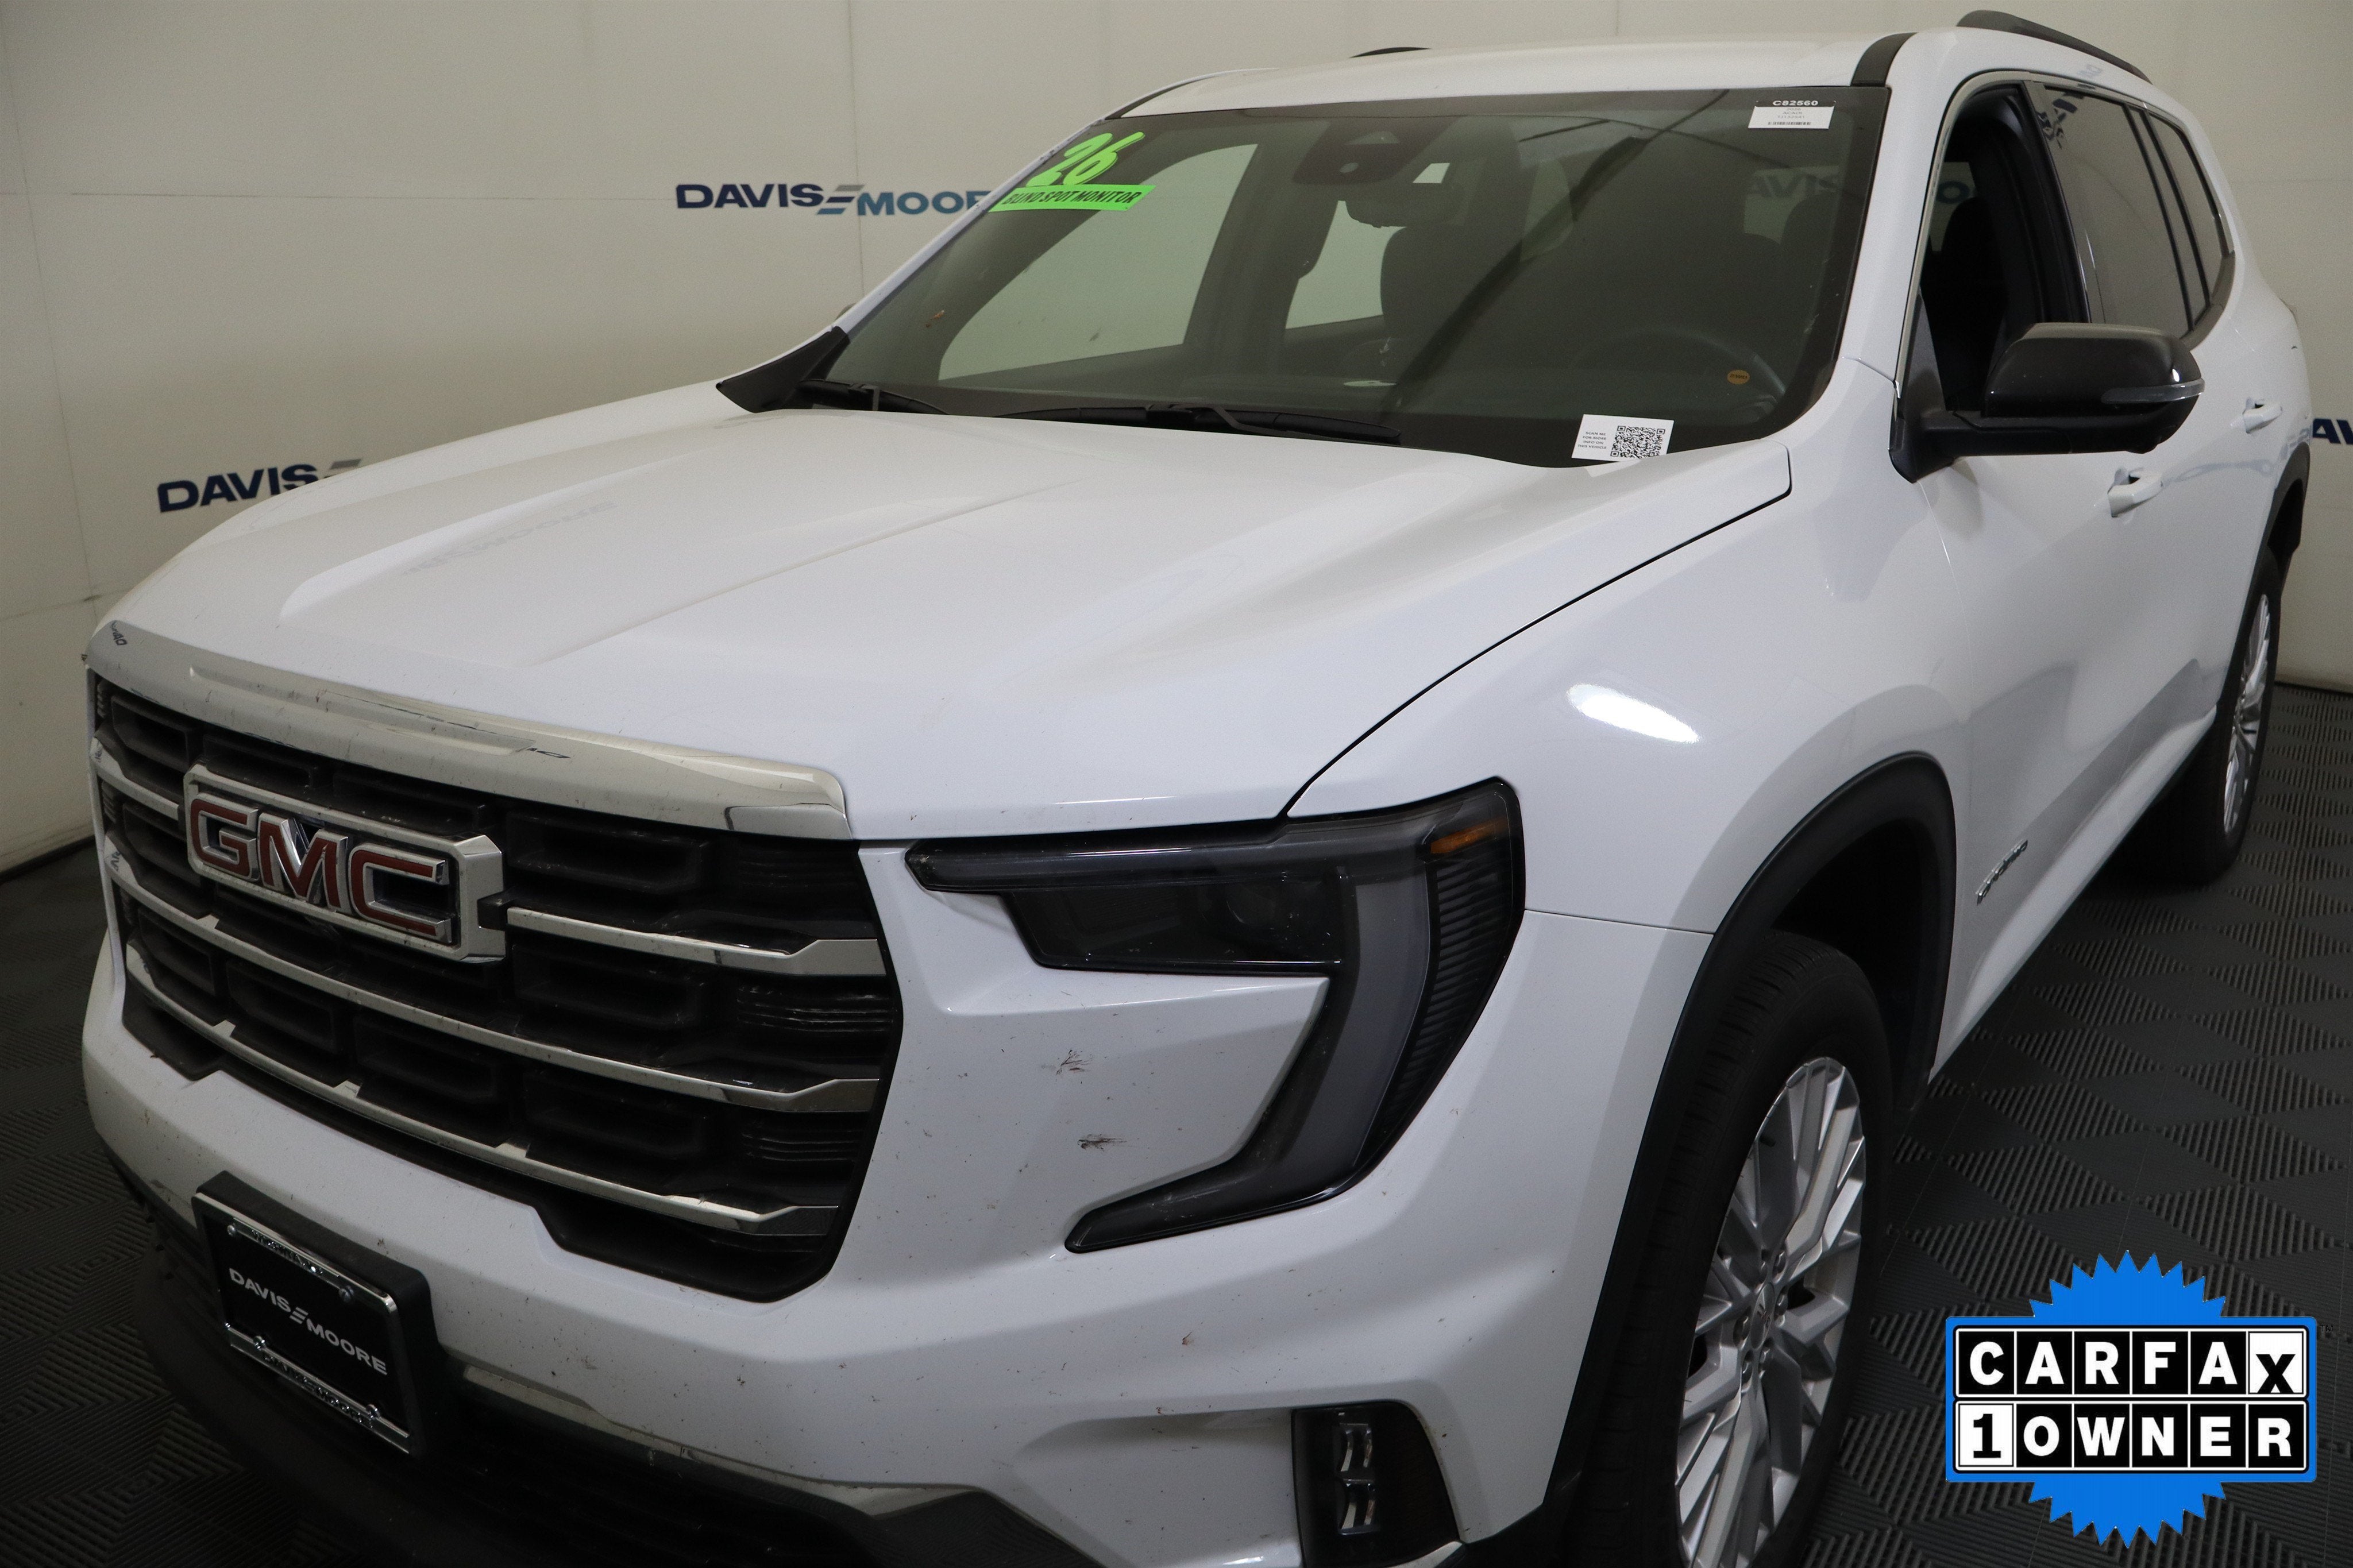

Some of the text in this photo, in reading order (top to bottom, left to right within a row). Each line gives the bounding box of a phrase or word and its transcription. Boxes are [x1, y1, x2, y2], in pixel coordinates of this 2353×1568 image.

[1026, 131, 1145, 187] 26
[1002, 190, 1142, 205] BLIND SPOT MONITOR
[157, 464, 318, 513] DAVIS
[189, 792, 454, 944] GMC
[229, 1268, 388, 1376] DAVIS MOORE
